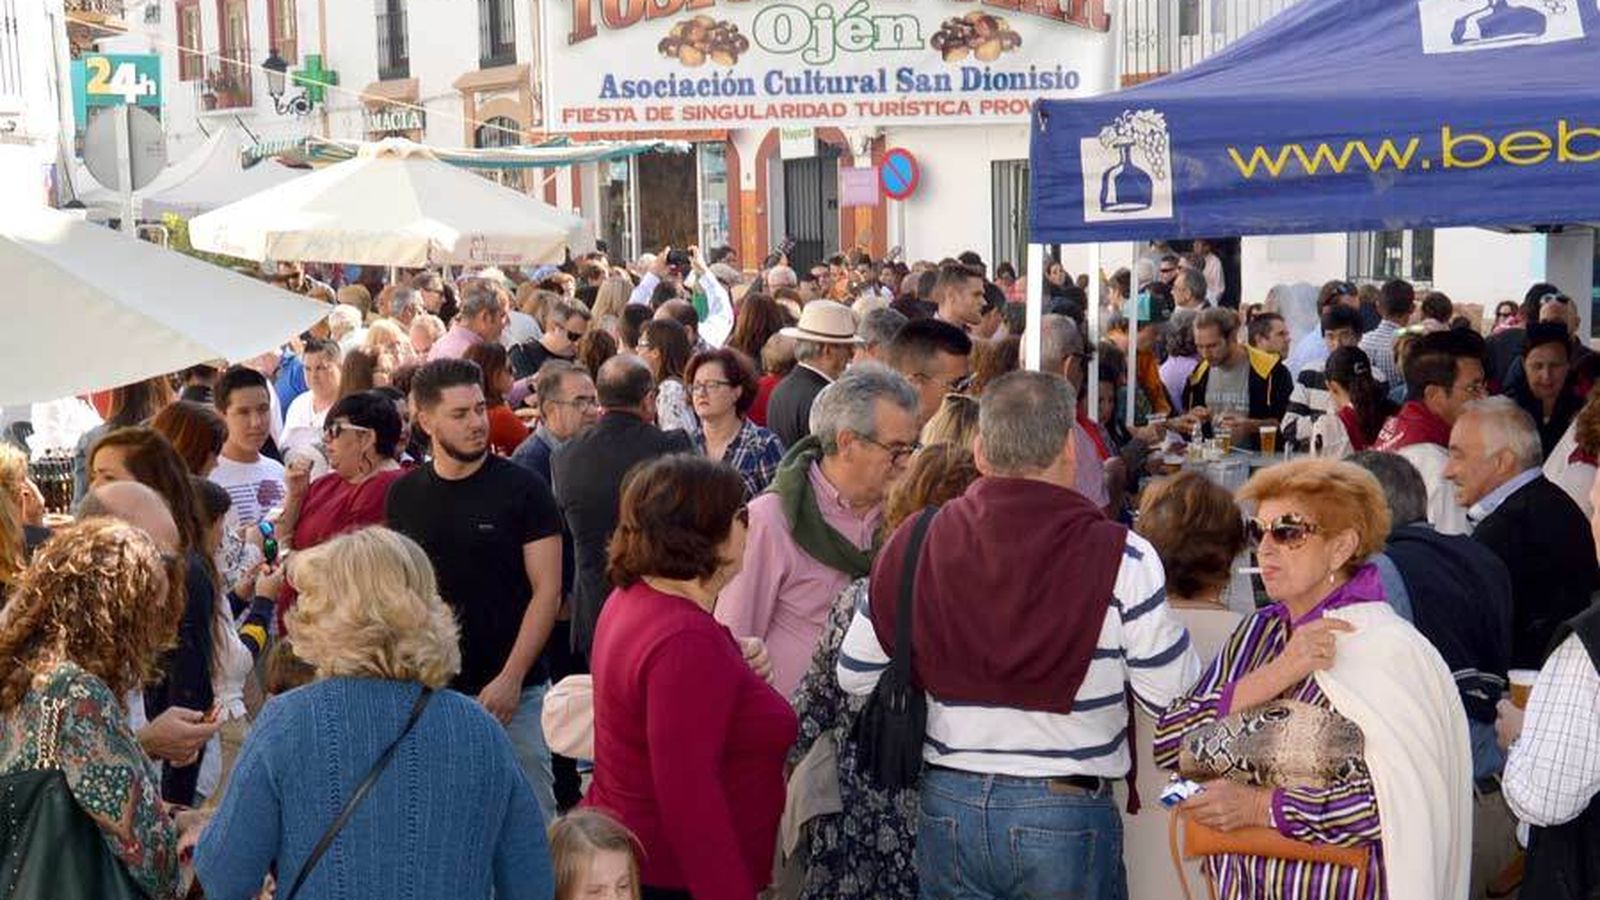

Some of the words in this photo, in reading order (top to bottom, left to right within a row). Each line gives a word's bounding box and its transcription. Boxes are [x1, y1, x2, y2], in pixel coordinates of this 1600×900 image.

[752, 2, 925, 65] Ojén
[86, 56, 157, 103] 24h
[598, 70, 756, 99] Asociación
[763, 68, 888, 96] Cultural
[895, 67, 953, 93] San
[960, 64, 1081, 92] Dionisio
[562, 107, 637, 123] FIESTA
[645, 106, 675, 122] DE
[682, 101, 846, 120] SINGULARIDAD
[857, 98, 971, 117] TURÍSTICA
[1228, 120, 1600, 178] www.beb
